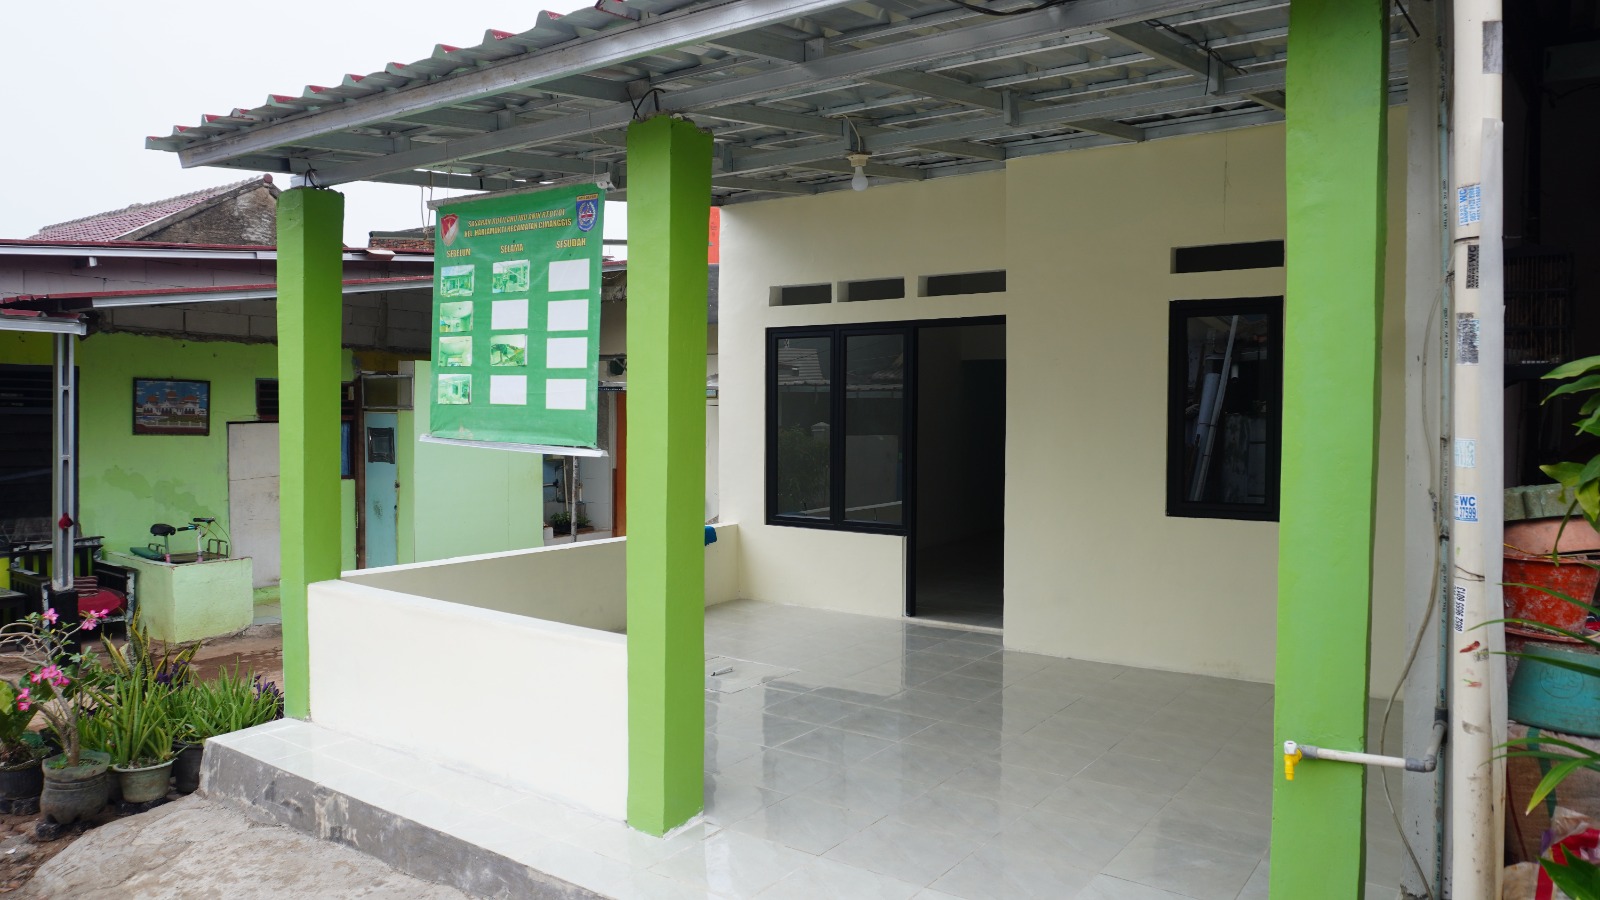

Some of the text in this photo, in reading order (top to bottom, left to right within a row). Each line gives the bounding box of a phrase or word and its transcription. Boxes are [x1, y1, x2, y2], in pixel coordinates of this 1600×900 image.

[1459, 188, 1467, 203] WC
[538, 218, 572, 229] CIMANGGIS
[500, 243, 524, 254] SELAMA
[555, 237, 586, 249] SESUDAH
[447, 248, 471, 258] SEBELUM
[1469, 246, 1477, 262] WC
[1459, 496, 1476, 507] WC
